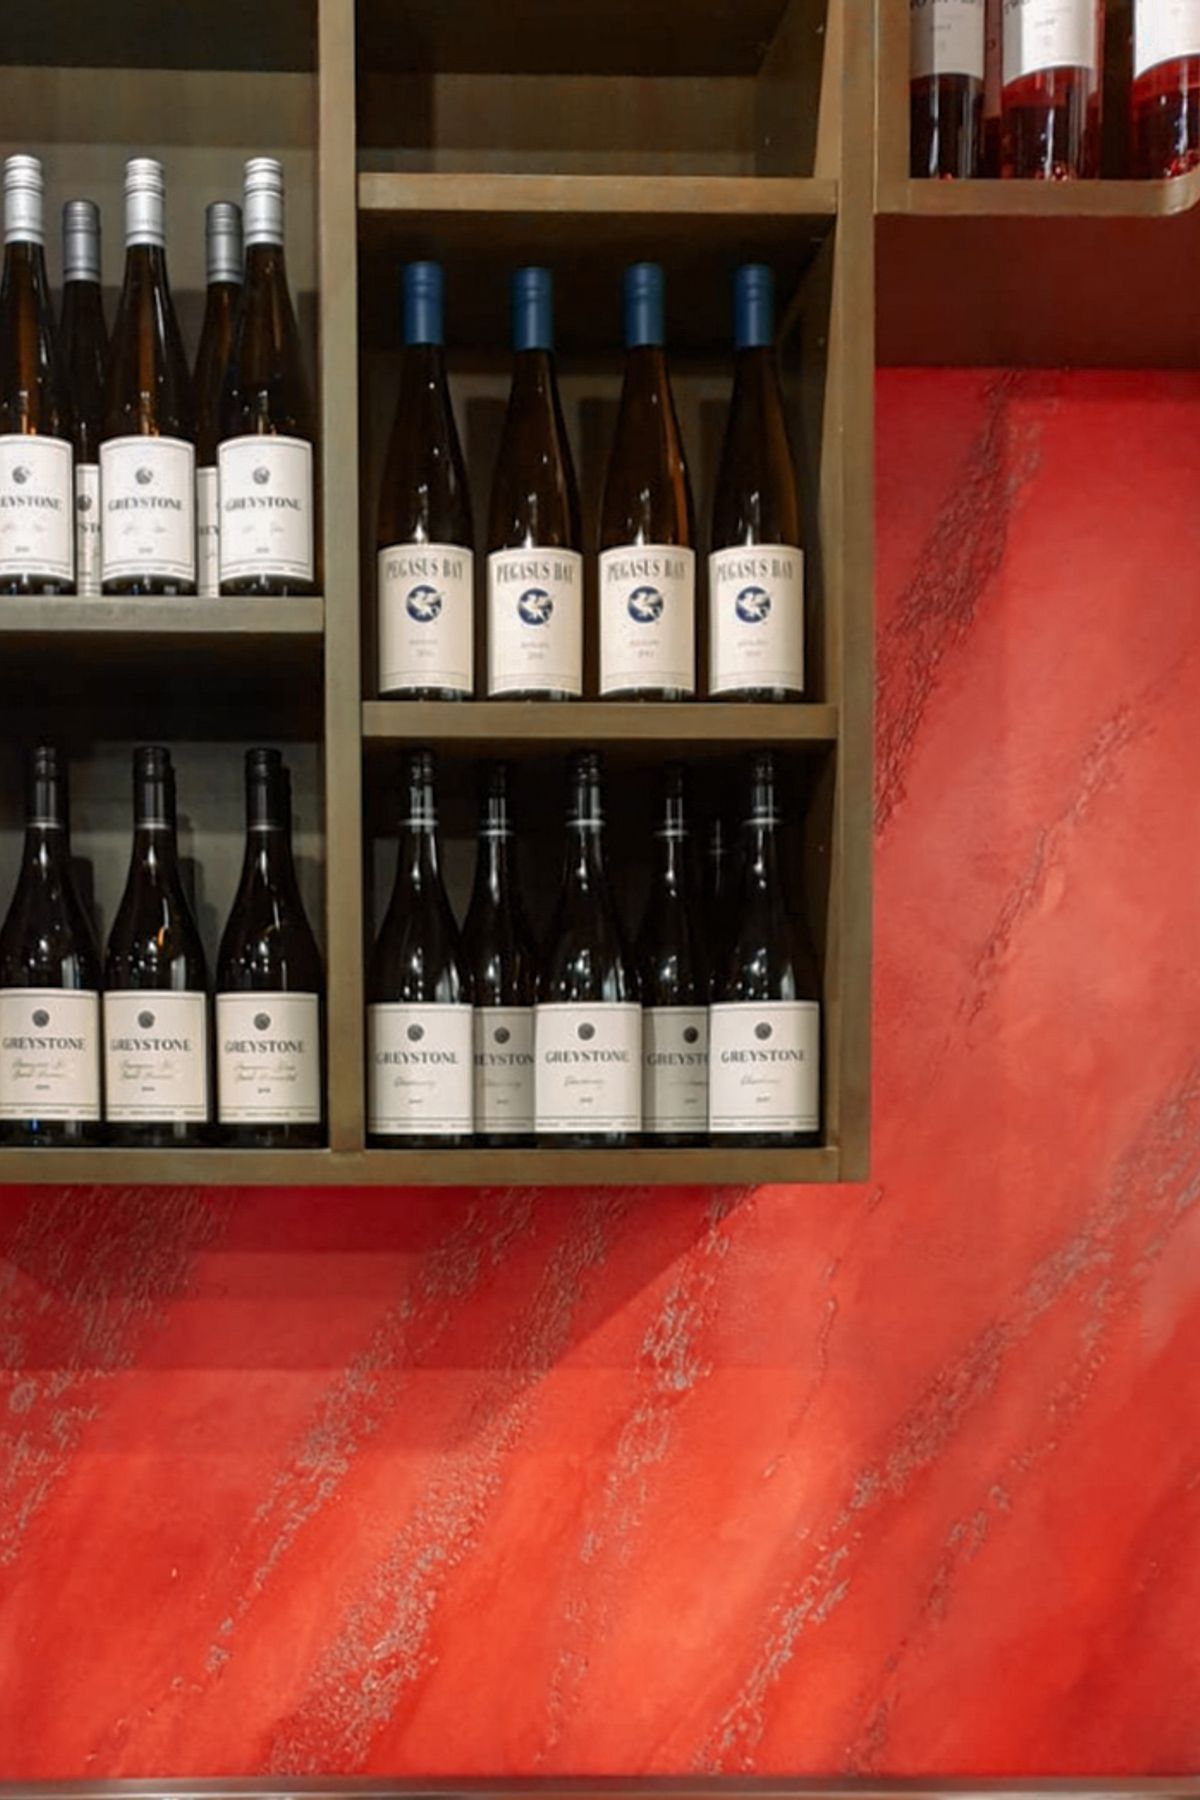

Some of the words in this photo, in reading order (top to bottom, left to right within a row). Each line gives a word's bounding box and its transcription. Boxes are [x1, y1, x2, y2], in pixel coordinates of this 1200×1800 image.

[108, 496, 182, 512] GREYSTONE
[225, 496, 302, 512] GREYSTONE
[386, 558, 438, 580] PEGASUS
[442, 558, 463, 580] BAY
[496, 562, 549, 584] PEGASUS
[553, 562, 574, 584] BAY
[607, 558, 660, 581] PEGASUS
[664, 559, 686, 580] BAY
[716, 559, 767, 582] PEGASUS
[771, 559, 794, 580] BAY
[3, 1037, 85, 1050] GREYSTONE
[110, 1038, 192, 1052] GREYSTONE
[225, 1040, 304, 1053] GREYSTONE
[375, 1051, 458, 1064] GREYSTONE
[545, 1050, 629, 1063] GREYSTONE
[721, 1049, 804, 1063] GREYSTONE
